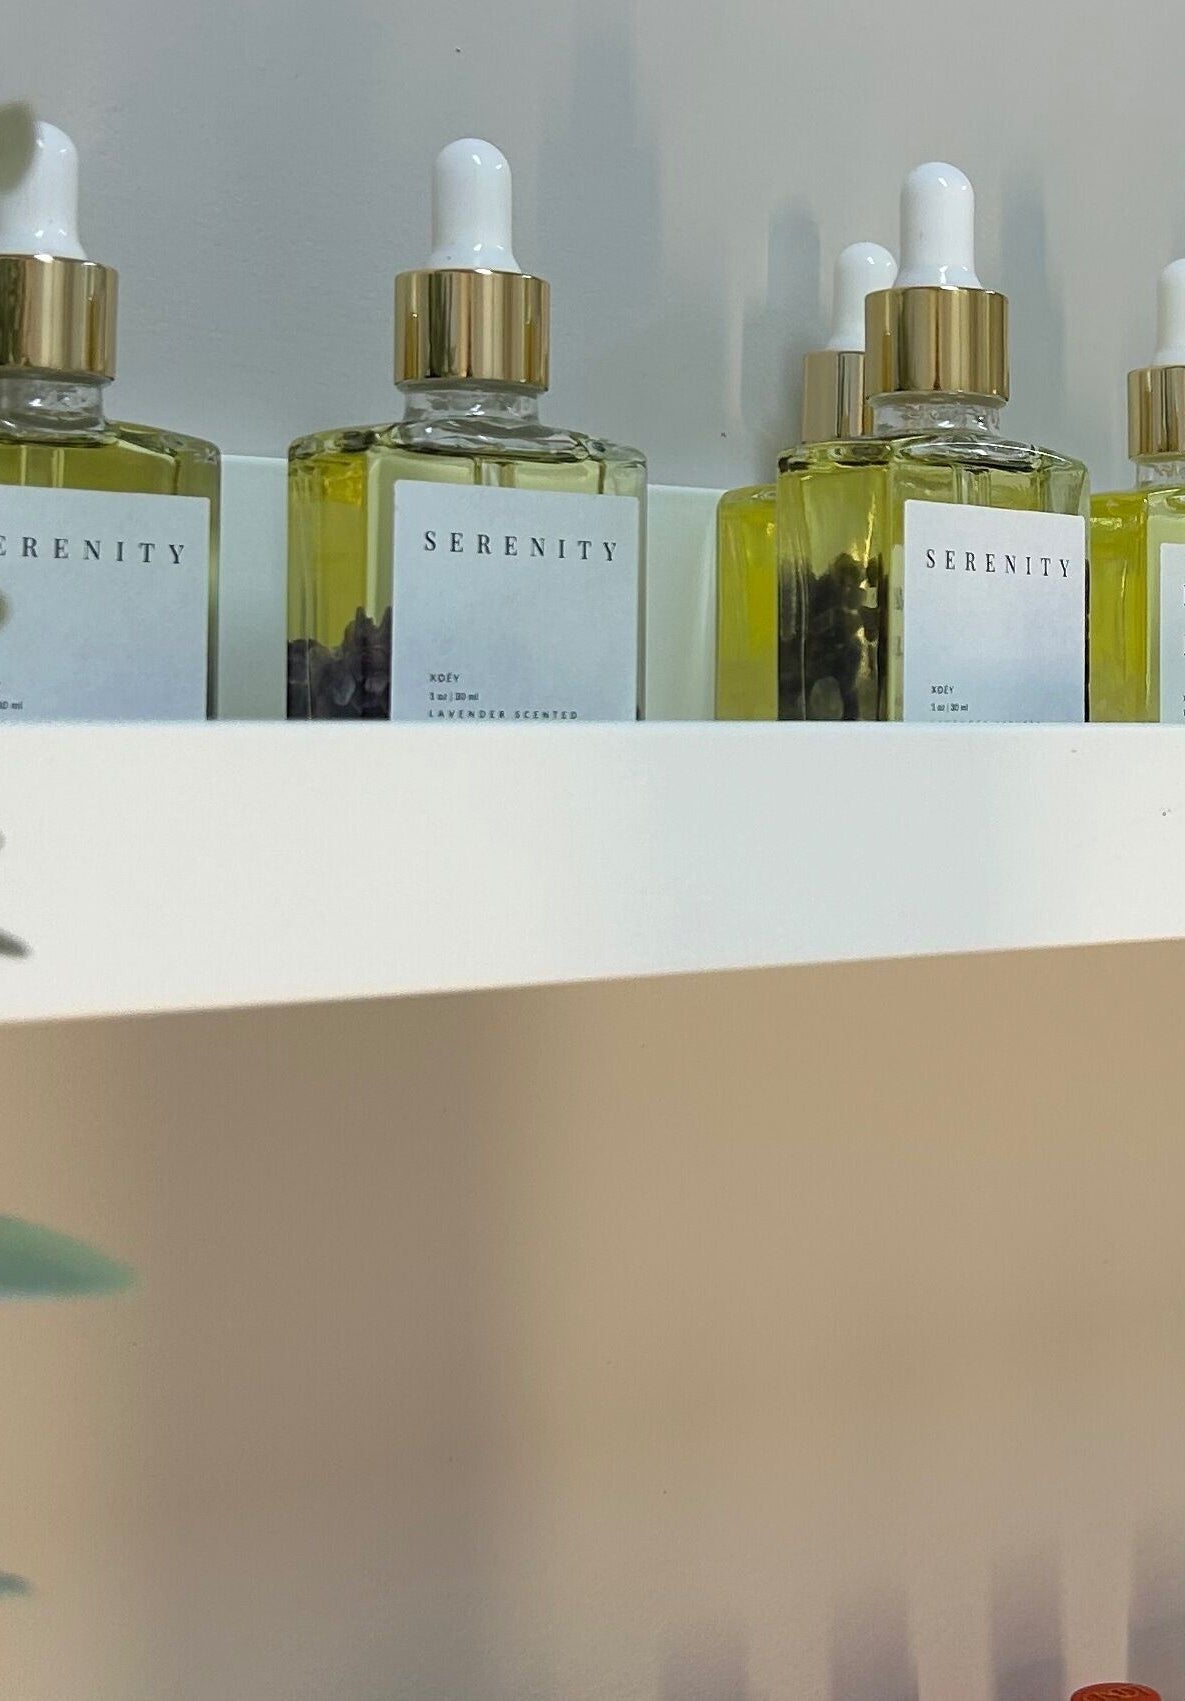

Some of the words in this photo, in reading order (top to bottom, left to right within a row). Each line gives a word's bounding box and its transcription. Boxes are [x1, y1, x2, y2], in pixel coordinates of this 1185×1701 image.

[424, 530, 617, 562] SERENITY
[926, 548, 1070, 578] SERENITY
[429, 710, 505, 719] LAVENDER
[515, 710, 578, 720] SCENTED
